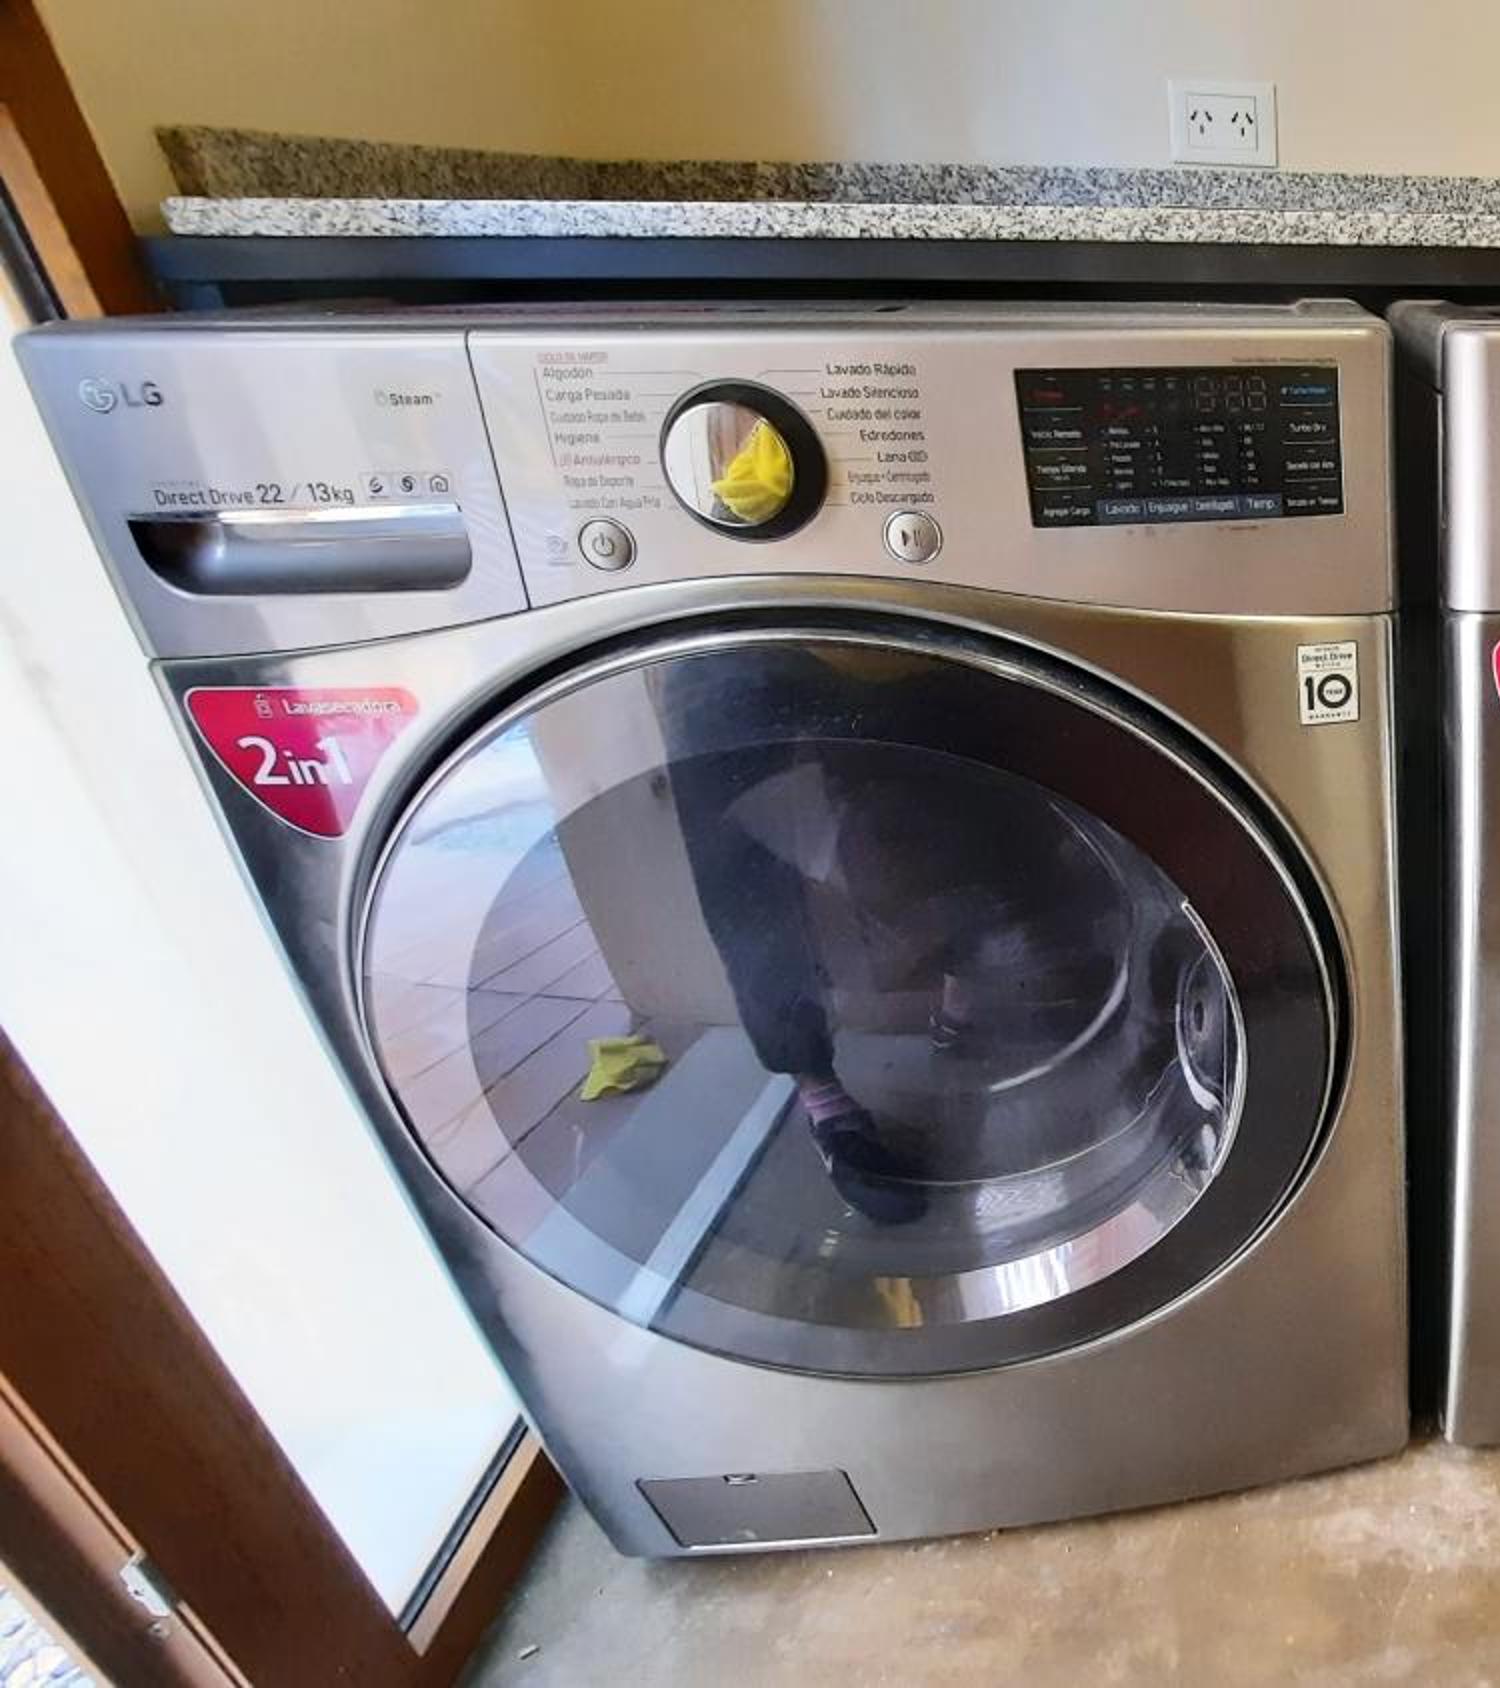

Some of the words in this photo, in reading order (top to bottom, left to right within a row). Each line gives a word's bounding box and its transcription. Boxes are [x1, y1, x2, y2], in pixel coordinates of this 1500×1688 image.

[826, 364, 871, 375] Lavado
[118, 382, 164, 408] LG
[389, 393, 433, 406] Steam
[546, 388, 583, 402] Carga
[820, 388, 861, 399] Lavado
[860, 429, 925, 442] Edredones
[877, 451, 906, 463] Lana
[153, 489, 207, 506] Direct
[208, 488, 254, 505] Drive
[256, 483, 285, 503] 22
[307, 482, 355, 505] 13kg
[1305, 673, 1353, 711] 10
